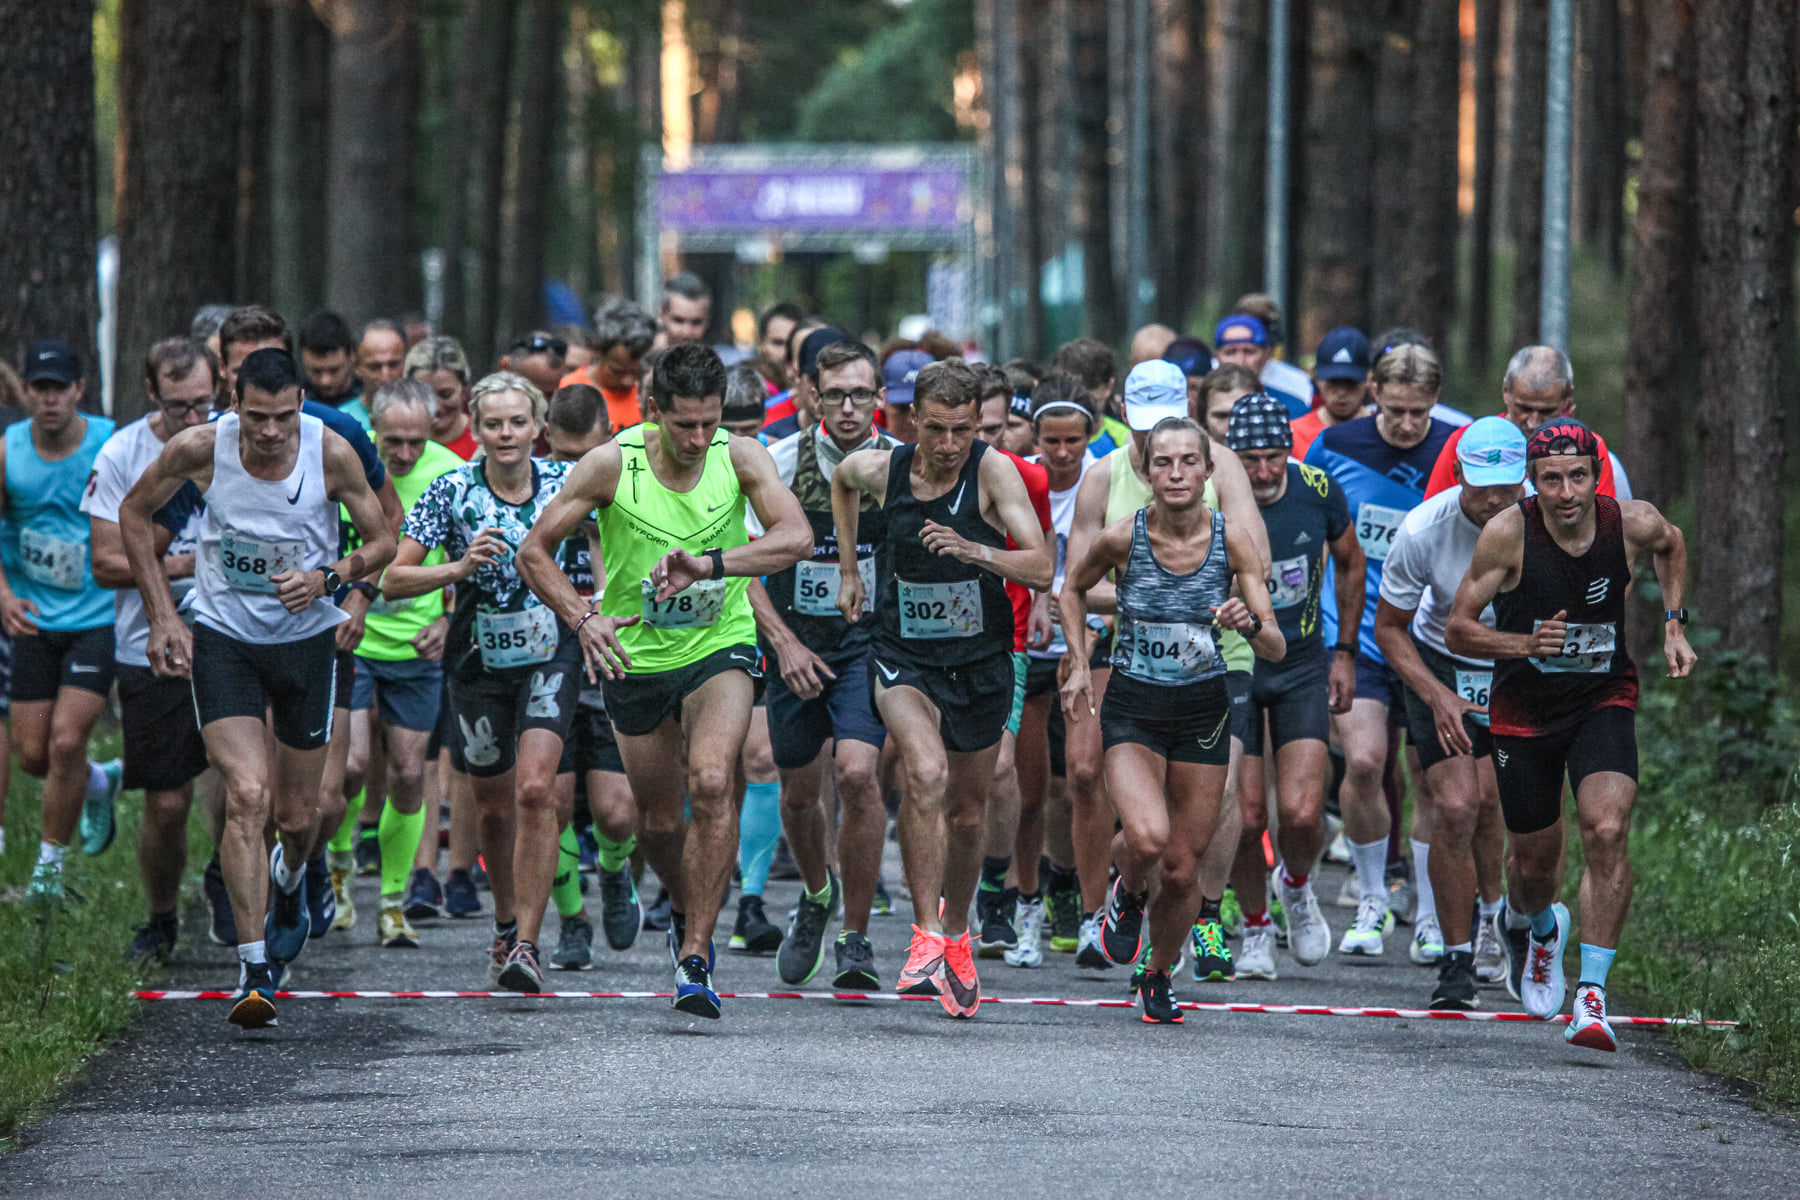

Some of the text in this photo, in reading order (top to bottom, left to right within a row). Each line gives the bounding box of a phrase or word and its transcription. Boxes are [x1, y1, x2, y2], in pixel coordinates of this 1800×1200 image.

[628, 521, 669, 548] SYFORM
[701, 518, 731, 545] SUUNTO
[1359, 521, 1397, 545] 376
[223, 550, 267, 575] 368
[800, 579, 829, 599] 56
[648, 595, 693, 614] 178
[903, 600, 948, 620] 302
[483, 629, 527, 650] 385
[1137, 638, 1180, 660] 304
